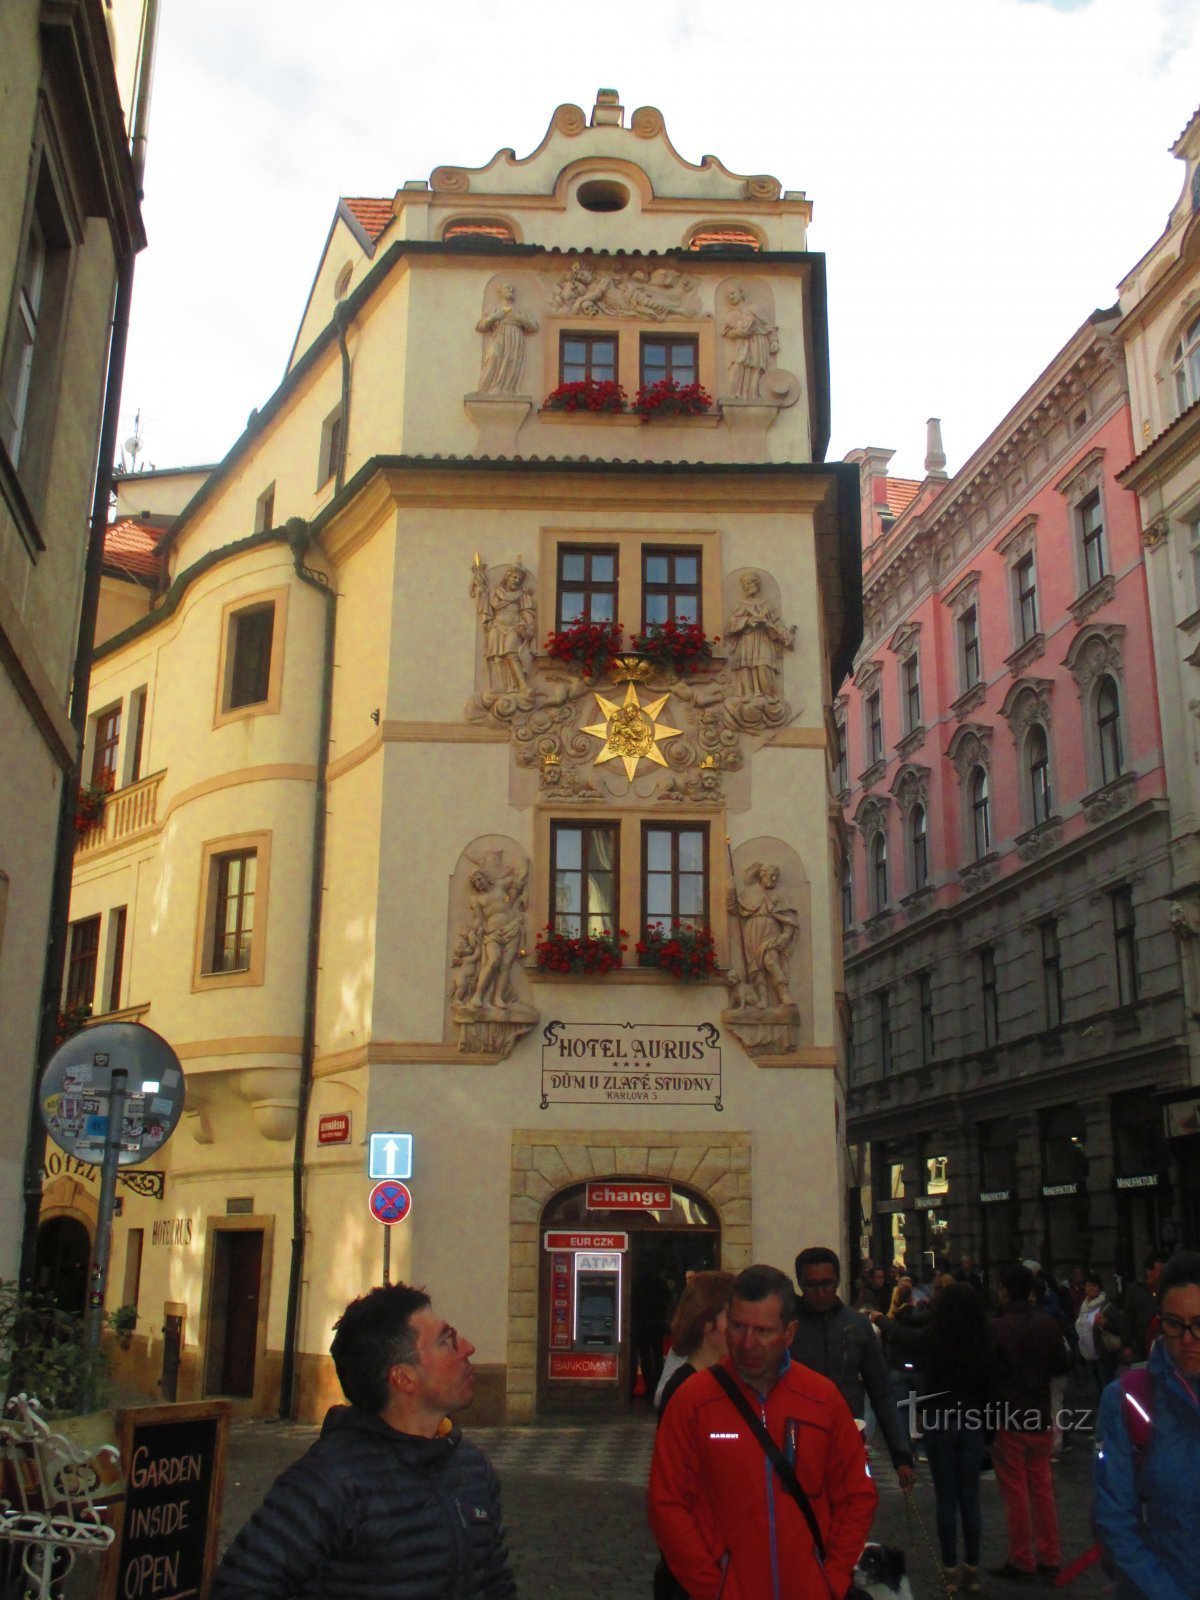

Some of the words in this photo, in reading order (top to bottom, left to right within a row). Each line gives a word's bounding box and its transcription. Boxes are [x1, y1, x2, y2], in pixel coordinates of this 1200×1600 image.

[559, 1038, 628, 1058] HOTEL
[631, 1039, 705, 1060] AURUS
[551, 1072, 586, 1089] DŮM
[589, 1076, 599, 1089] U
[602, 1073, 651, 1091] ZLATÉ
[654, 1077, 713, 1092] STUDNY
[606, 1091, 649, 1101] KARLOVA
[592, 1188, 667, 1205] change
[570, 1237, 591, 1247] EUR
[593, 1238, 614, 1247] CZK
[580, 1257, 618, 1269] ATM
[553, 1360, 613, 1372] BANKOMAT
[131, 1446, 202, 1489] GARDEN
[129, 1500, 191, 1539] INSIDE
[125, 1551, 180, 1600] OPEN
